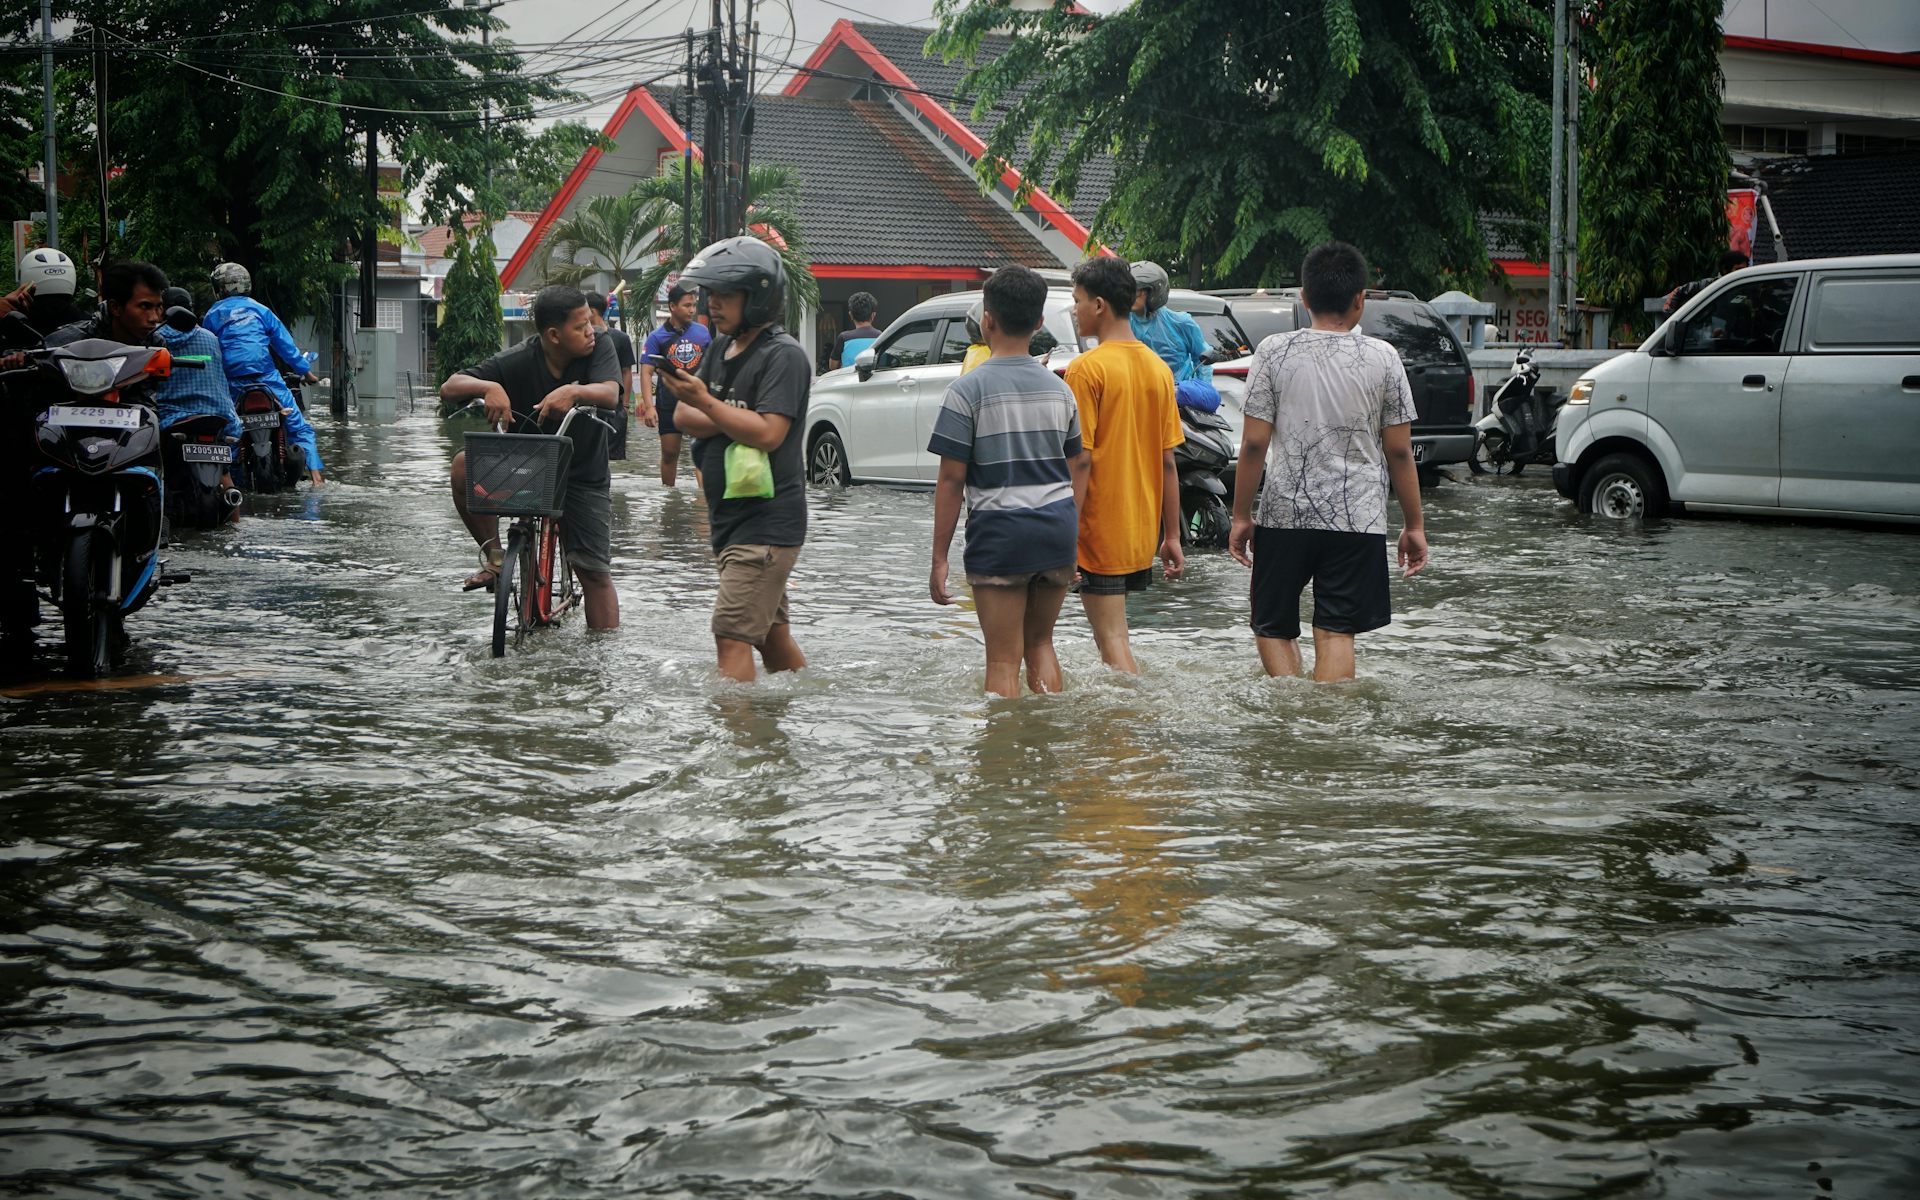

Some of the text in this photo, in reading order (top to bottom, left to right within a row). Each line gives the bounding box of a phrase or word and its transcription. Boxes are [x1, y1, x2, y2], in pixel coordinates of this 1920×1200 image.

[51, 407, 134, 418] H 2429 DY
[193, 447, 212, 455] 2005
